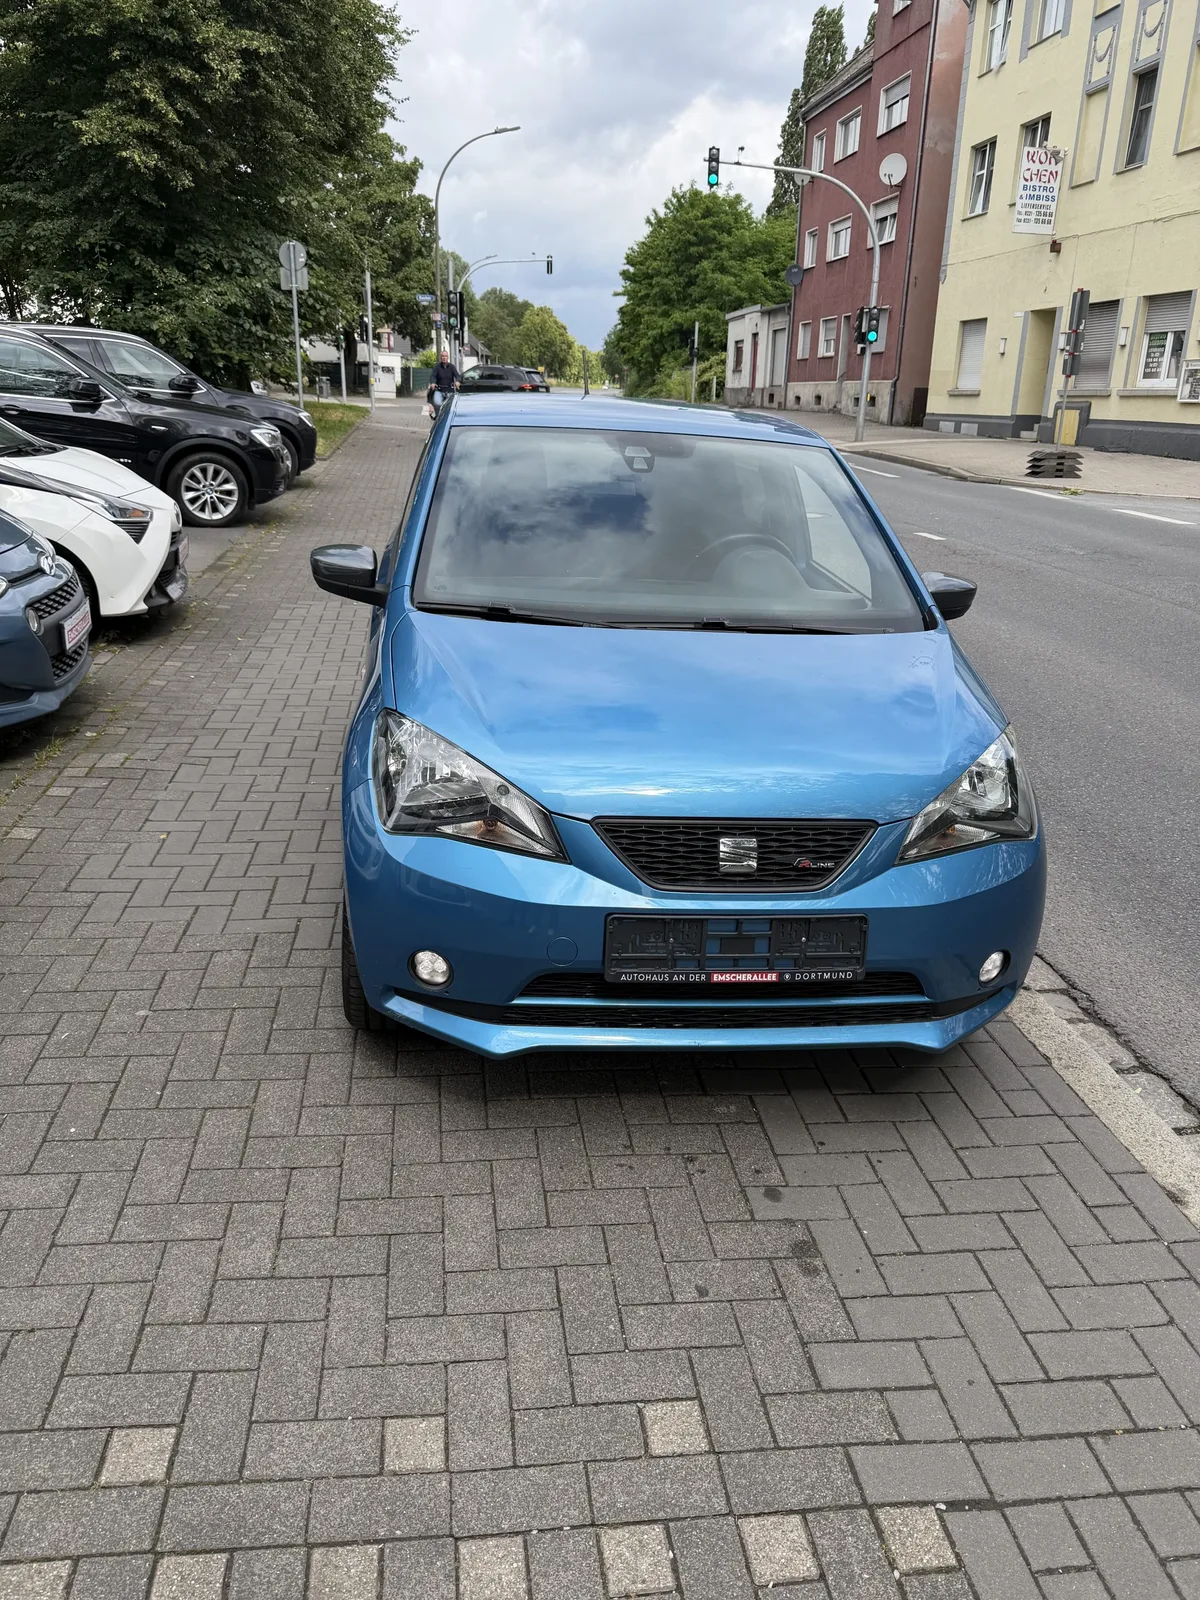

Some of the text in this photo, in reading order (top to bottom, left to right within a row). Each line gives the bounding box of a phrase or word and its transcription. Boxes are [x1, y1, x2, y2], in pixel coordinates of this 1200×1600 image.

[1022, 168, 1059, 184] CHEN
[1022, 184, 1055, 193] BISTRO
[1025, 193, 1056, 202] IMBISS
[620, 971, 853, 981] AUTOHAUS AN DER EMSCHERALLEE DORTMUND
